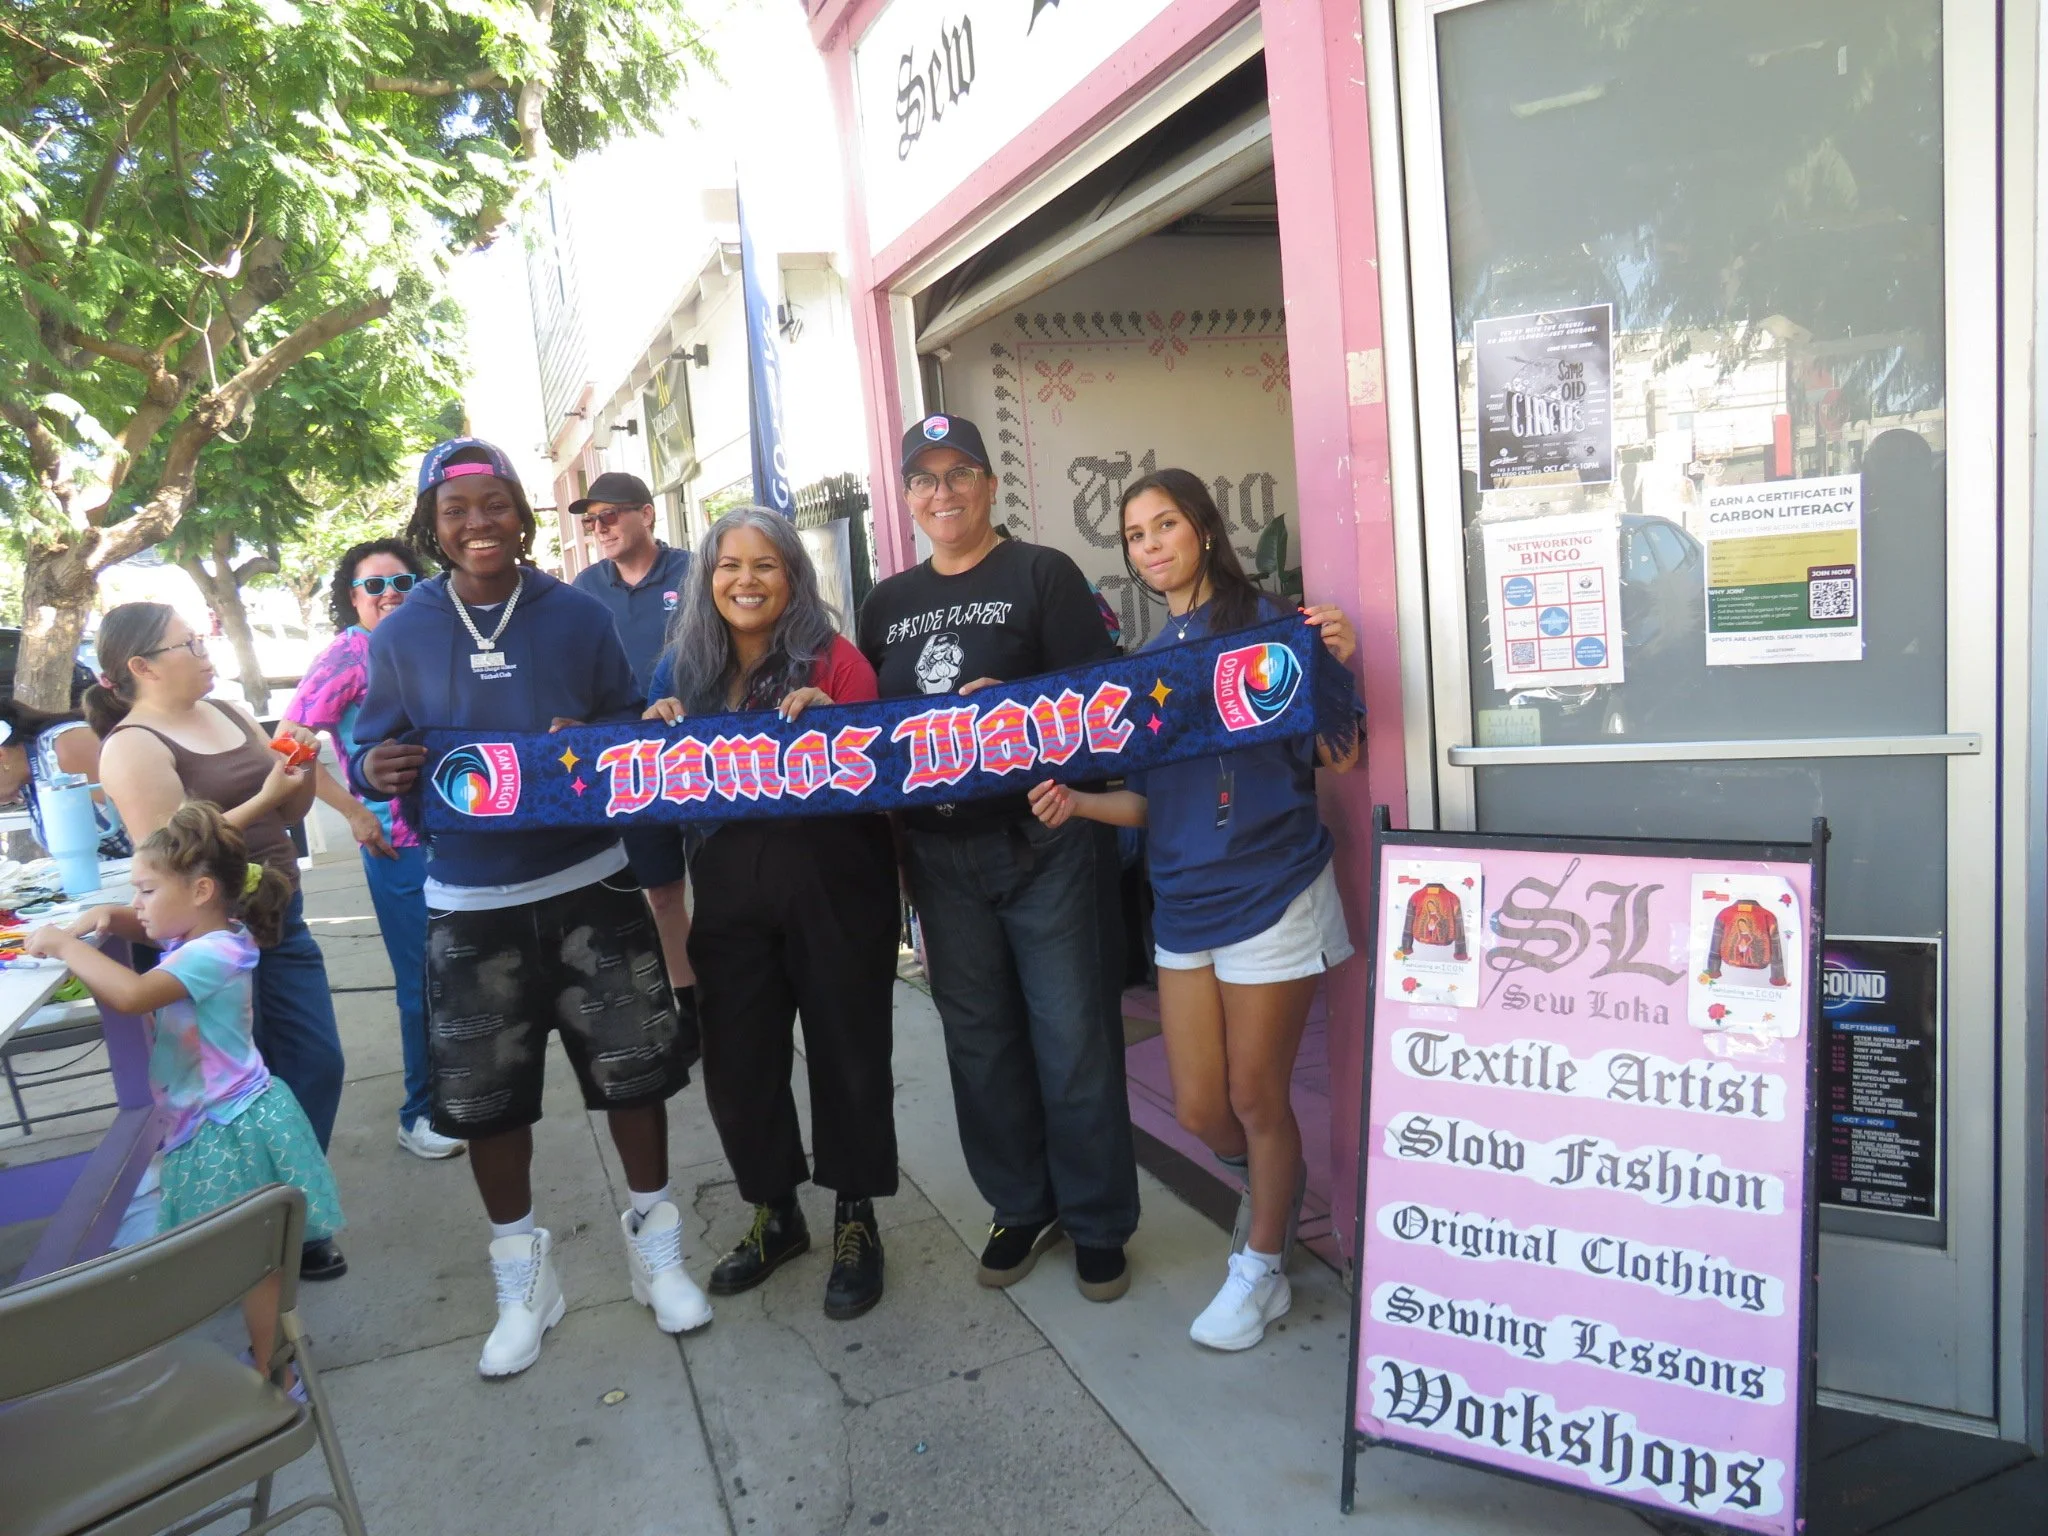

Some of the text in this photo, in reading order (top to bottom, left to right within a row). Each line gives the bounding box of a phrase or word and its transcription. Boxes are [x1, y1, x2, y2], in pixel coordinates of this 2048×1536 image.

[896, 14, 975, 161] Sew
[1558, 360, 1583, 381] Same
[1512, 393, 1586, 437] CIRCUS
[1543, 464, 1558, 473] OCT
[1710, 486, 1852, 507] EARN A CERTIFICATE IN
[1710, 501, 1854, 523] CARBON LITERACY
[1508, 536, 1592, 552] NETWORKING
[1520, 548, 1580, 565] BINGO
[1831, 568, 1852, 576] NOW
[946, 601, 1013, 628] PLAYERS
[1221, 657, 1246, 724] SAN DIEGO
[596, 680, 1135, 817] Vamos Wave
[493, 748, 515, 809] SAN DIEGO
[1441, 964, 1464, 973] ICON
[1501, 984, 1670, 1025] Sew Loka
[1754, 990, 1783, 1000] ICON
[1840, 1023, 1889, 1032] SEPTEMBER
[1405, 1031, 1769, 1118] Textile Artist
[1399, 1115, 1525, 1172] Slow
[1550, 1138, 1766, 1211] Fashion
[1393, 1205, 1766, 1311] Original Clothing
[1386, 1285, 1766, 1399] Sewing Lessons
[1381, 1360, 1766, 1510] Workshops
